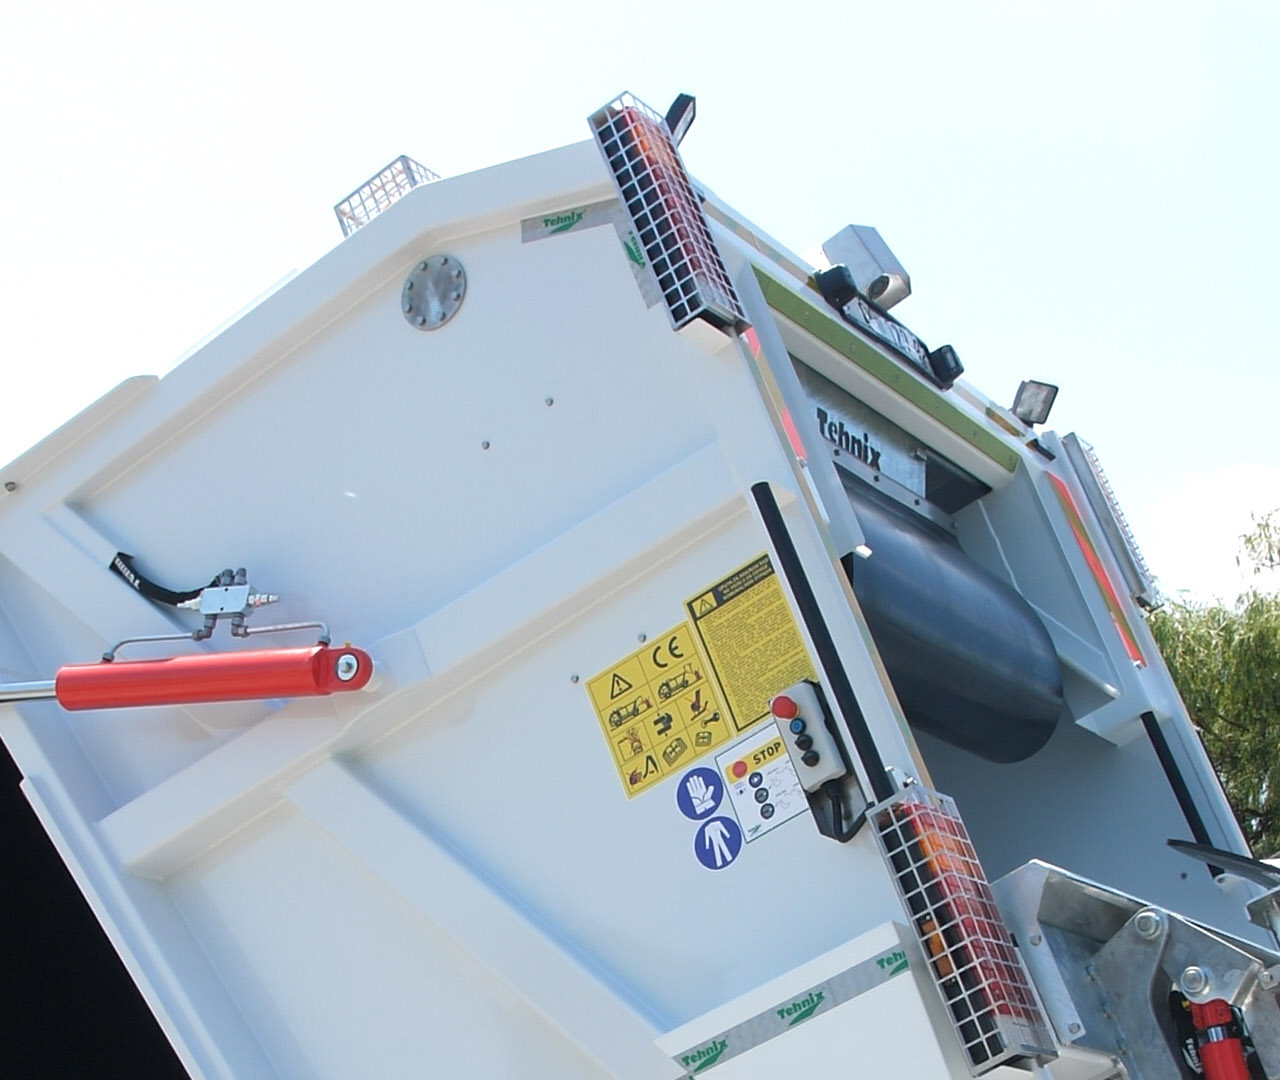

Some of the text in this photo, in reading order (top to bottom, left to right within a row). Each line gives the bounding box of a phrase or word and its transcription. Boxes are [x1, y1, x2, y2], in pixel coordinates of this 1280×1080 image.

[816, 406, 881, 473] Tehnix
[752, 741, 782, 766] STOP
[777, 988, 826, 1020] Tehnix
[681, 1037, 729, 1067] Tehnix
